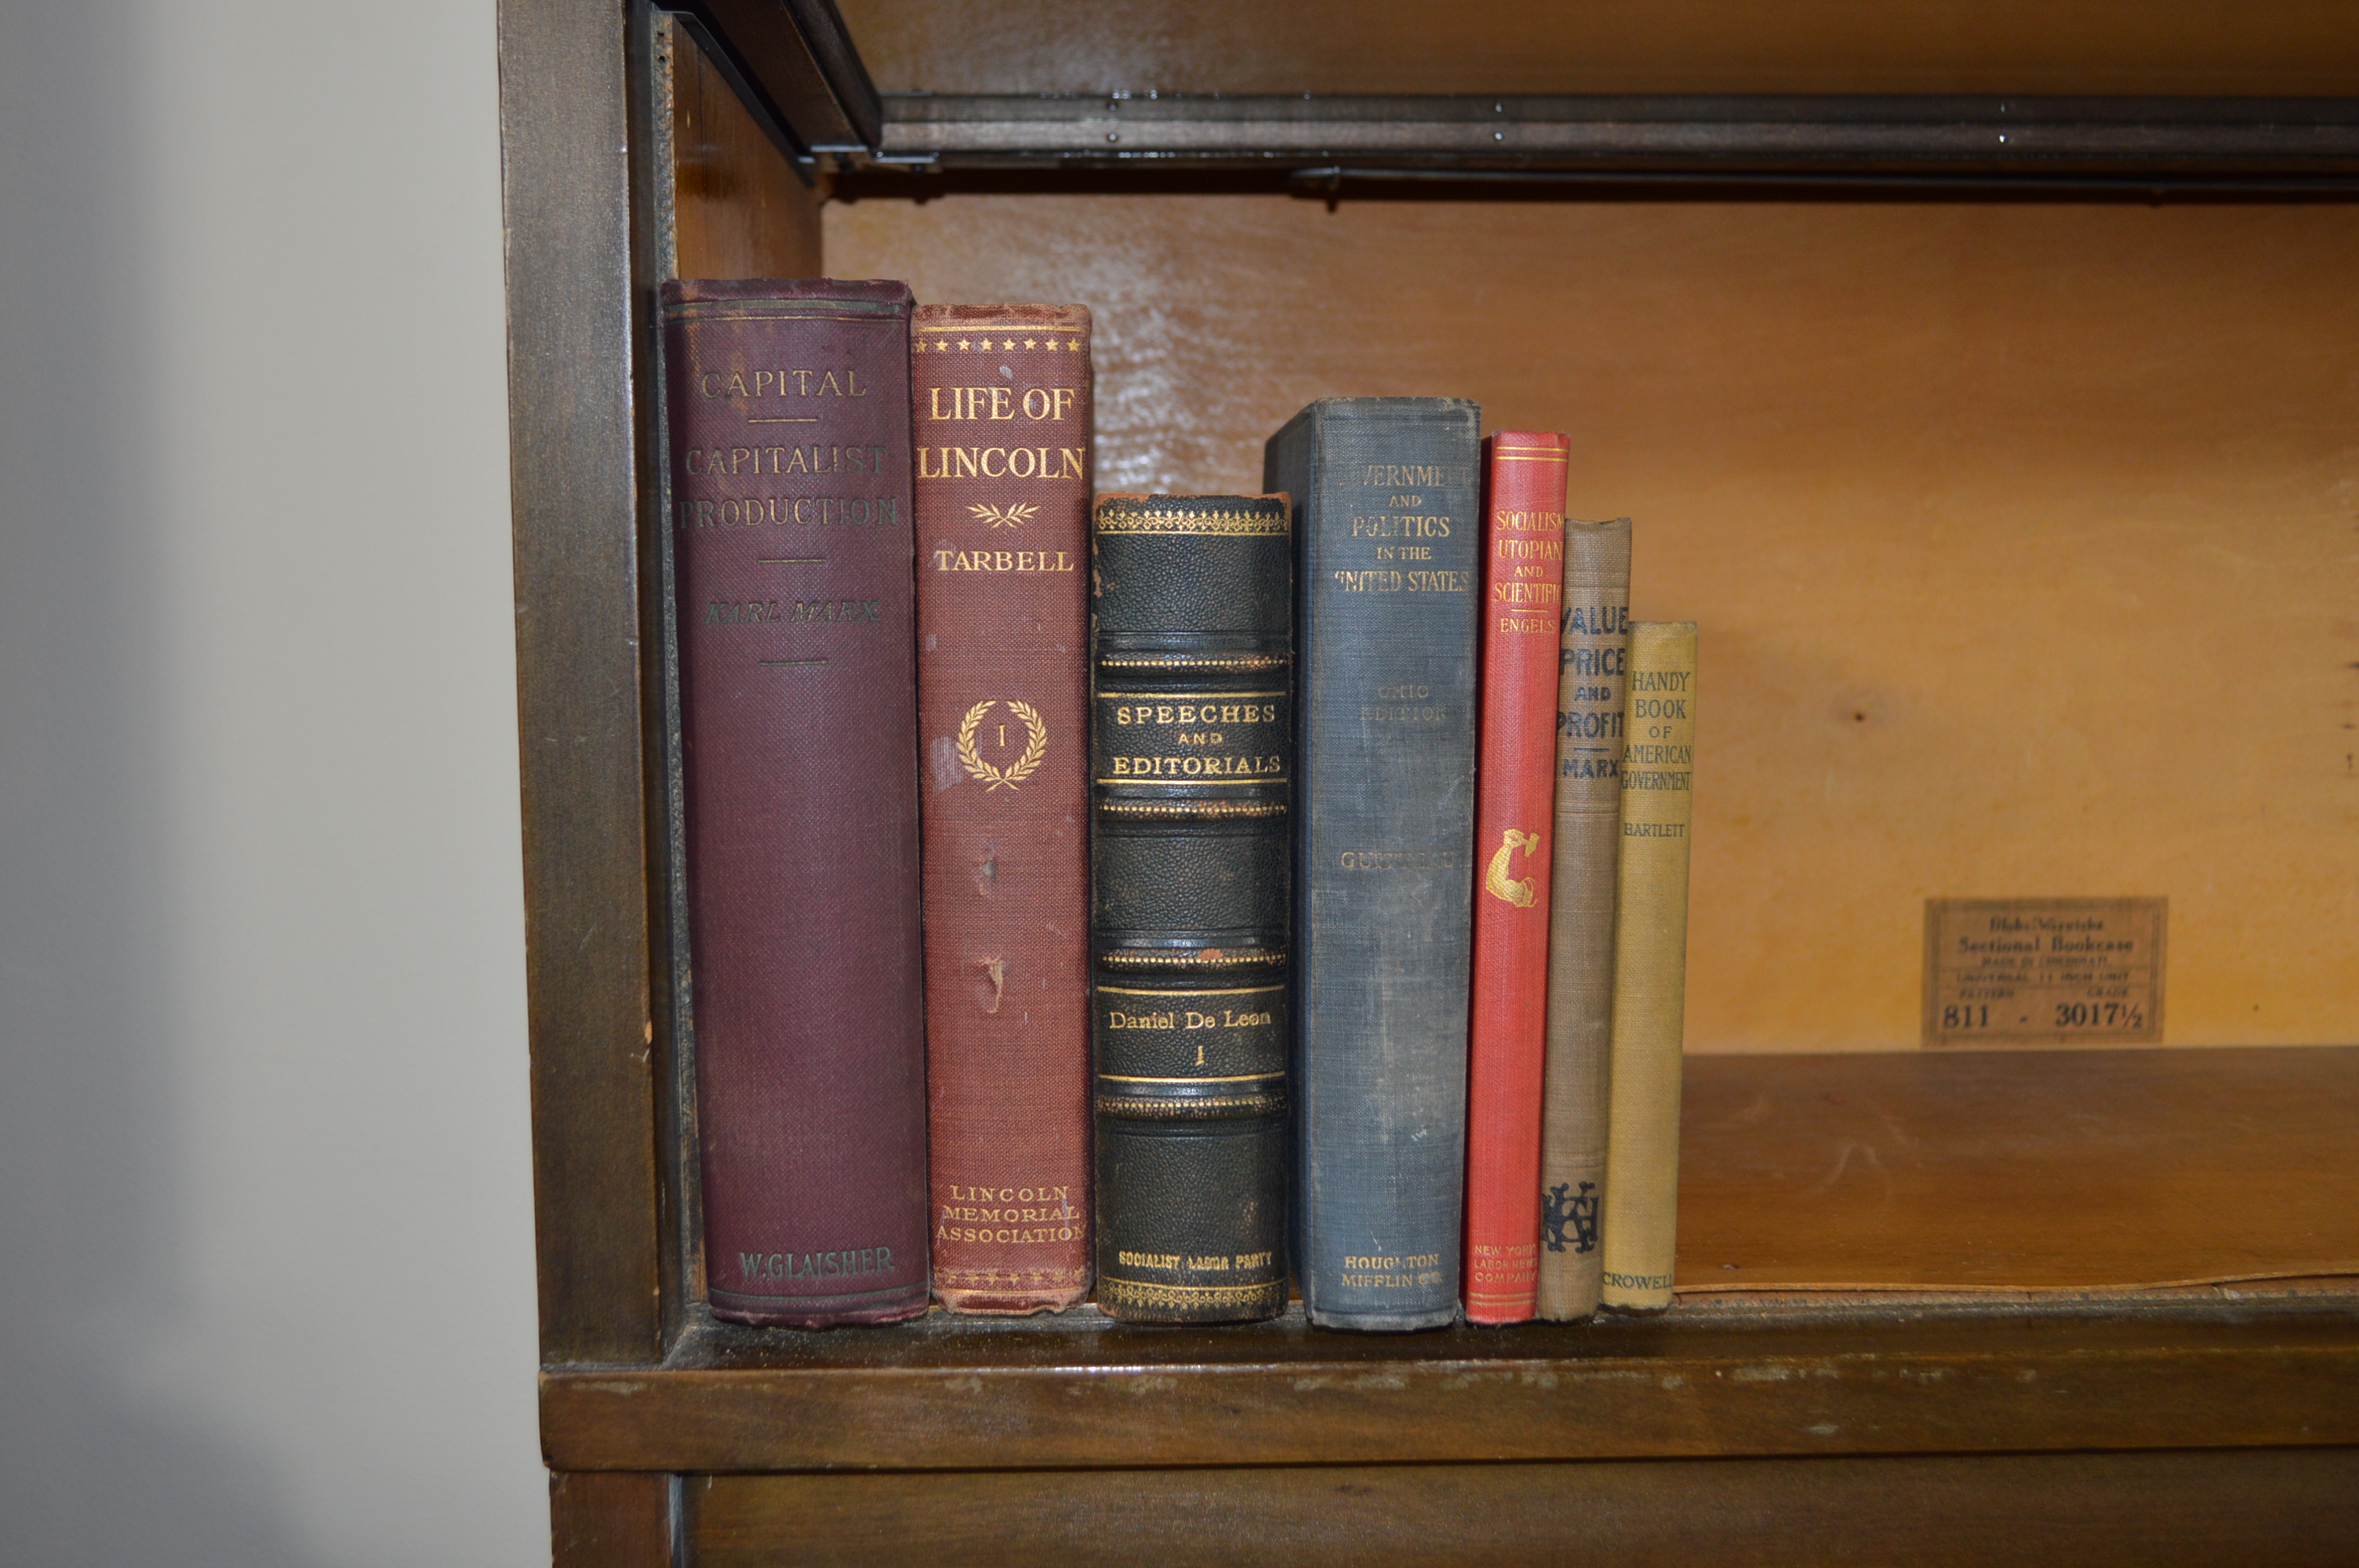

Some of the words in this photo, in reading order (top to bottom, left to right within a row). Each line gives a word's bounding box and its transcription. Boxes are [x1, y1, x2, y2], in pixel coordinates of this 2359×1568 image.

[701, 370, 867, 398] CAPITAL
[929, 387, 1013, 420] LIFE
[1023, 388, 1075, 420] OF
[686, 446, 887, 475] CAPITALIST
[918, 447, 1085, 480] LINCOLN
[1388, 495, 1423, 507] AND
[680, 499, 897, 529] PRODUCTION
[1351, 516, 1450, 537] POLITICS
[1376, 546, 1394, 560] IN
[1398, 546, 1432, 560] THE
[1499, 539, 1563, 561] UTOPIAN
[936, 551, 1074, 572] TARBELL
[1514, 565, 1544, 578] AND
[1407, 570, 1470, 591] STATES
[704, 602, 780, 624] KARL
[790, 601, 880, 622] MARX
[1500, 617, 1556, 634] ENGELS
[1559, 648, 1626, 677] PRICE
[1631, 671, 1690, 691] HANDY
[1574, 687, 1612, 702] AND
[1117, 704, 1275, 724] SPEECHES
[1635, 699, 1686, 719] BOOK
[1178, 732, 1223, 744] AND
[1648, 725, 1673, 739] OF
[1622, 745, 1692, 764] AMERICAN
[1113, 755, 1281, 775] EDITORIALS
[1562, 759, 1618, 779] MARX
[1621, 771, 1691, 791] GOVERNMENT
[1623, 822, 1685, 837] BARTLETT
[1109, 1011, 1176, 1029] Daniel
[1185, 1011, 1216, 1029] De
[1223, 1009, 1271, 1028] Leon
[1943, 1003, 1989, 1029] 811
[950, 1185, 1069, 1202] LINCOLN
[943, 1205, 1079, 1222] MEMORIAL
[936, 1225, 1086, 1243] ASSOCIATION
[1474, 1245, 1501, 1255] NEW
[1507, 1244, 1536, 1255] YORK
[740, 1247, 895, 1279] W.GLAISHER
[1118, 1250, 1180, 1269] SOCIALIST
[1187, 1255, 1230, 1270] LABOR
[1234, 1251, 1272, 1269] PARTY
[1474, 1258, 1508, 1270] LABOR
[1342, 1273, 1412, 1287] MIFFLIN
[1475, 1271, 1536, 1283] COMPANY
